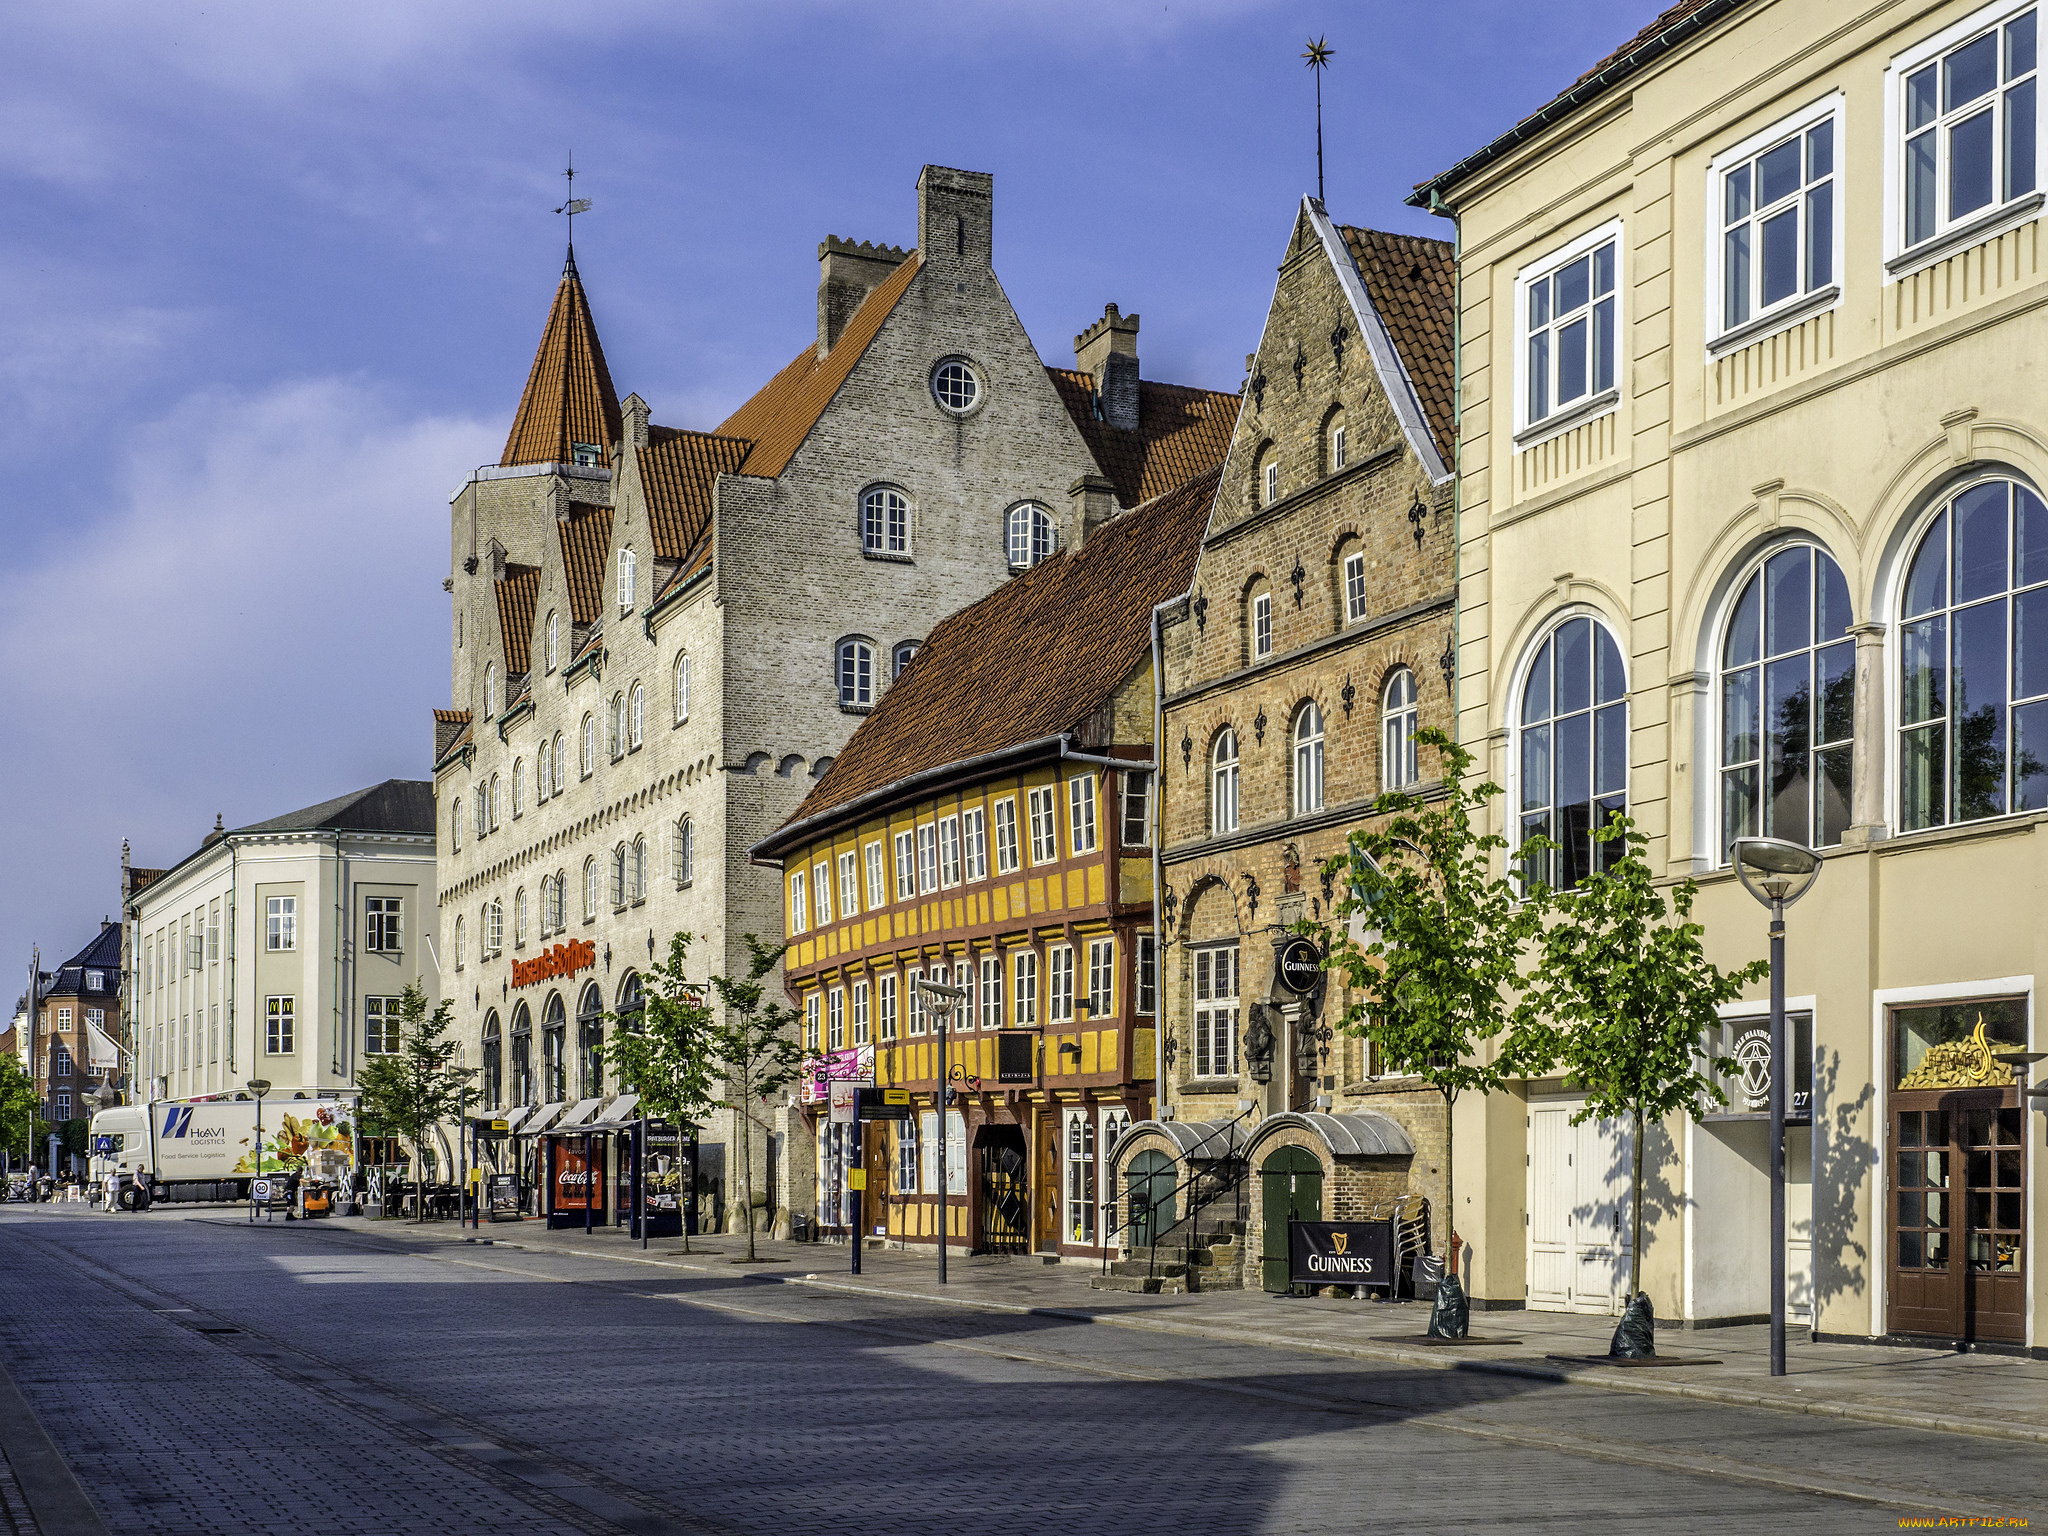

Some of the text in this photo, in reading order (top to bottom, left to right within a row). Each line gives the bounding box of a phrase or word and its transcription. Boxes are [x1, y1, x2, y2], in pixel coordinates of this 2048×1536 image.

[511, 948, 553, 989] Jensen's
[1284, 961, 1319, 972] GUINNESS
[817, 1069, 827, 1081] 23
[833, 1090, 854, 1108] SL
[1793, 1091, 1809, 1106] 27
[191, 1138, 226, 1146] LOGISTICS
[200, 1151, 226, 1159] Logistics
[1308, 1254, 1373, 1273] GUINNESS
